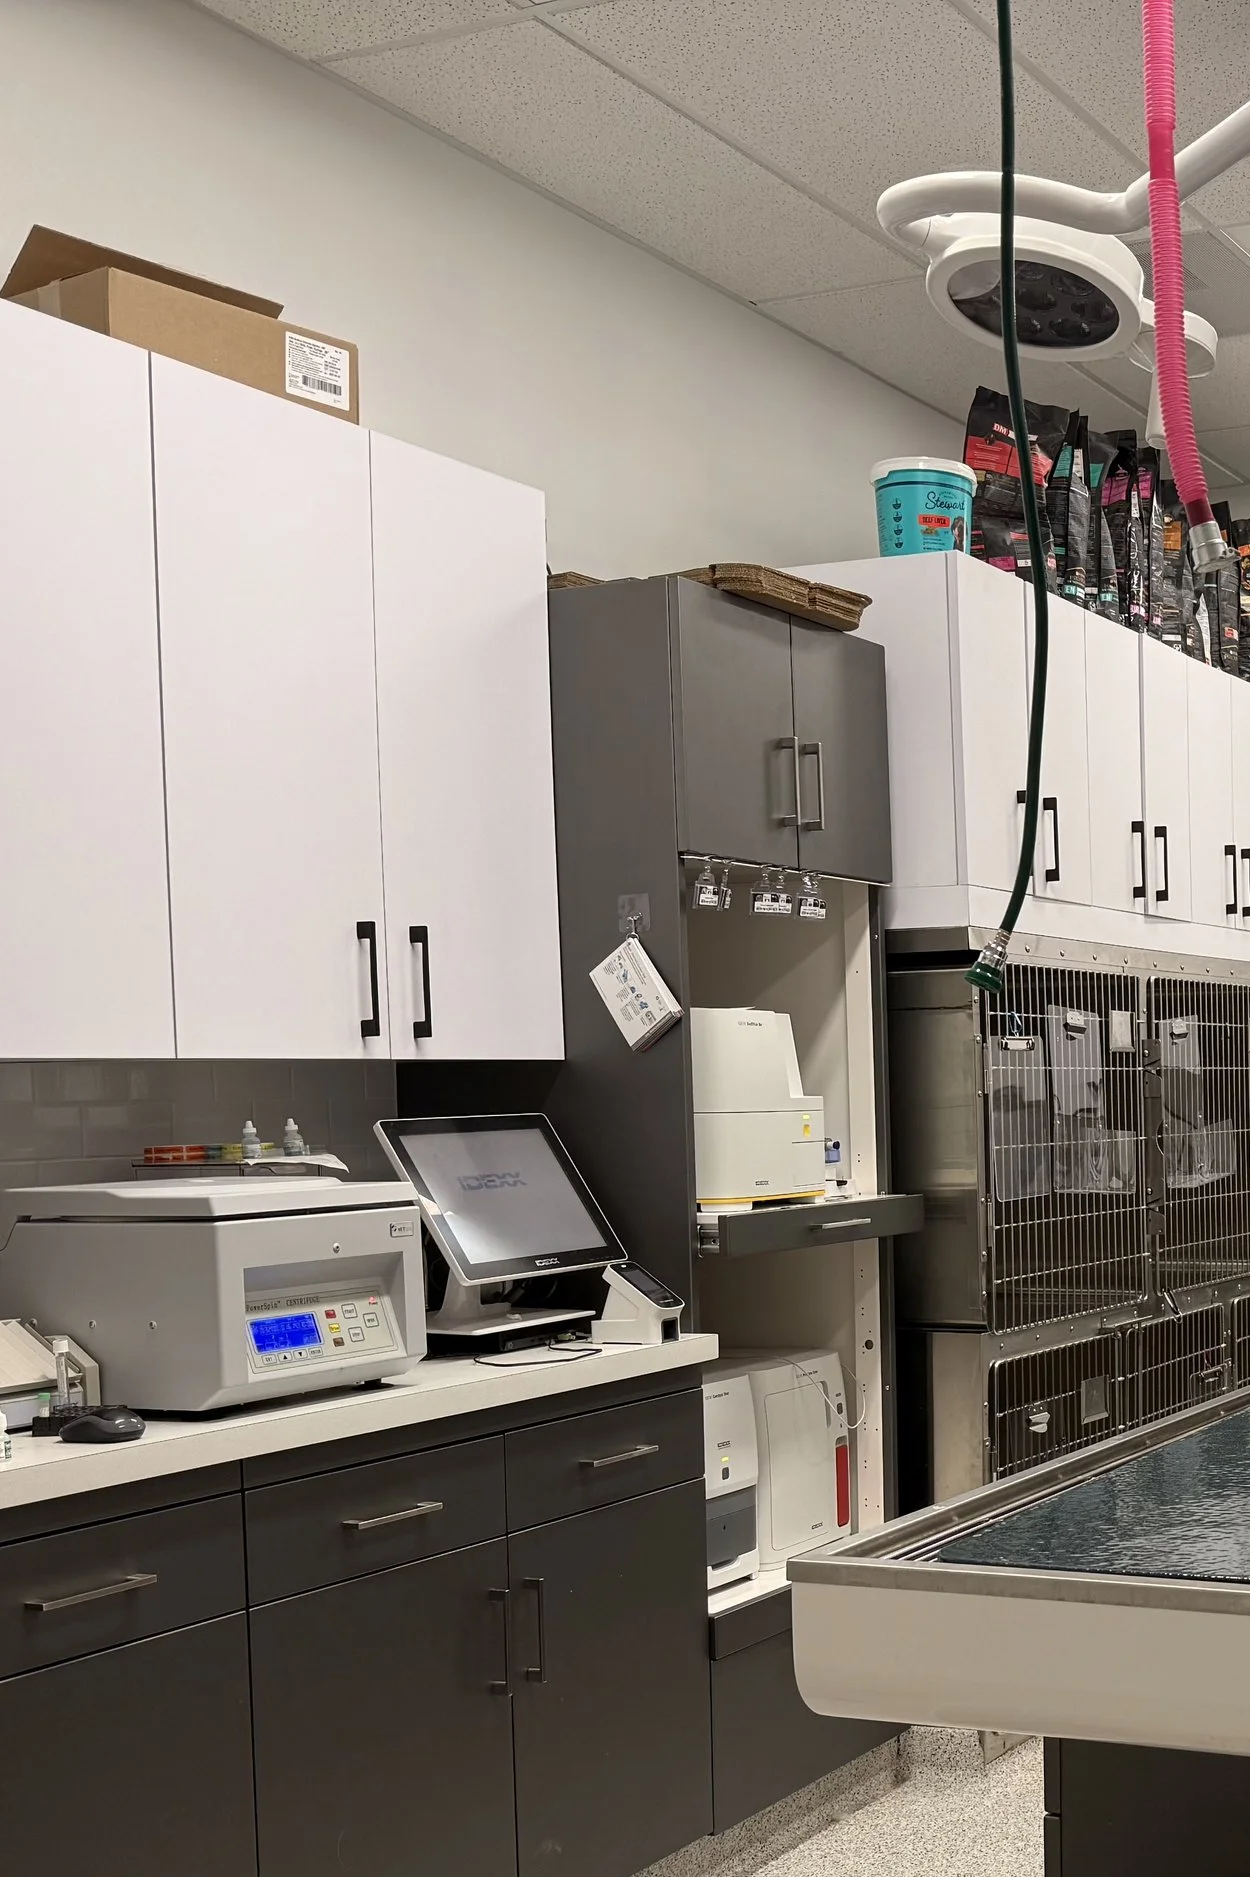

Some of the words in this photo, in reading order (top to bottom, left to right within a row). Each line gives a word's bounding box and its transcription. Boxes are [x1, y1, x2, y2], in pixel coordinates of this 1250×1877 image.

[925, 491, 965, 510] Stewart
[457, 1171, 527, 1191] IDEXX
[535, 1257, 560, 1267] IDEXX
[286, 1295, 320, 1307] CENTRIFUGE
